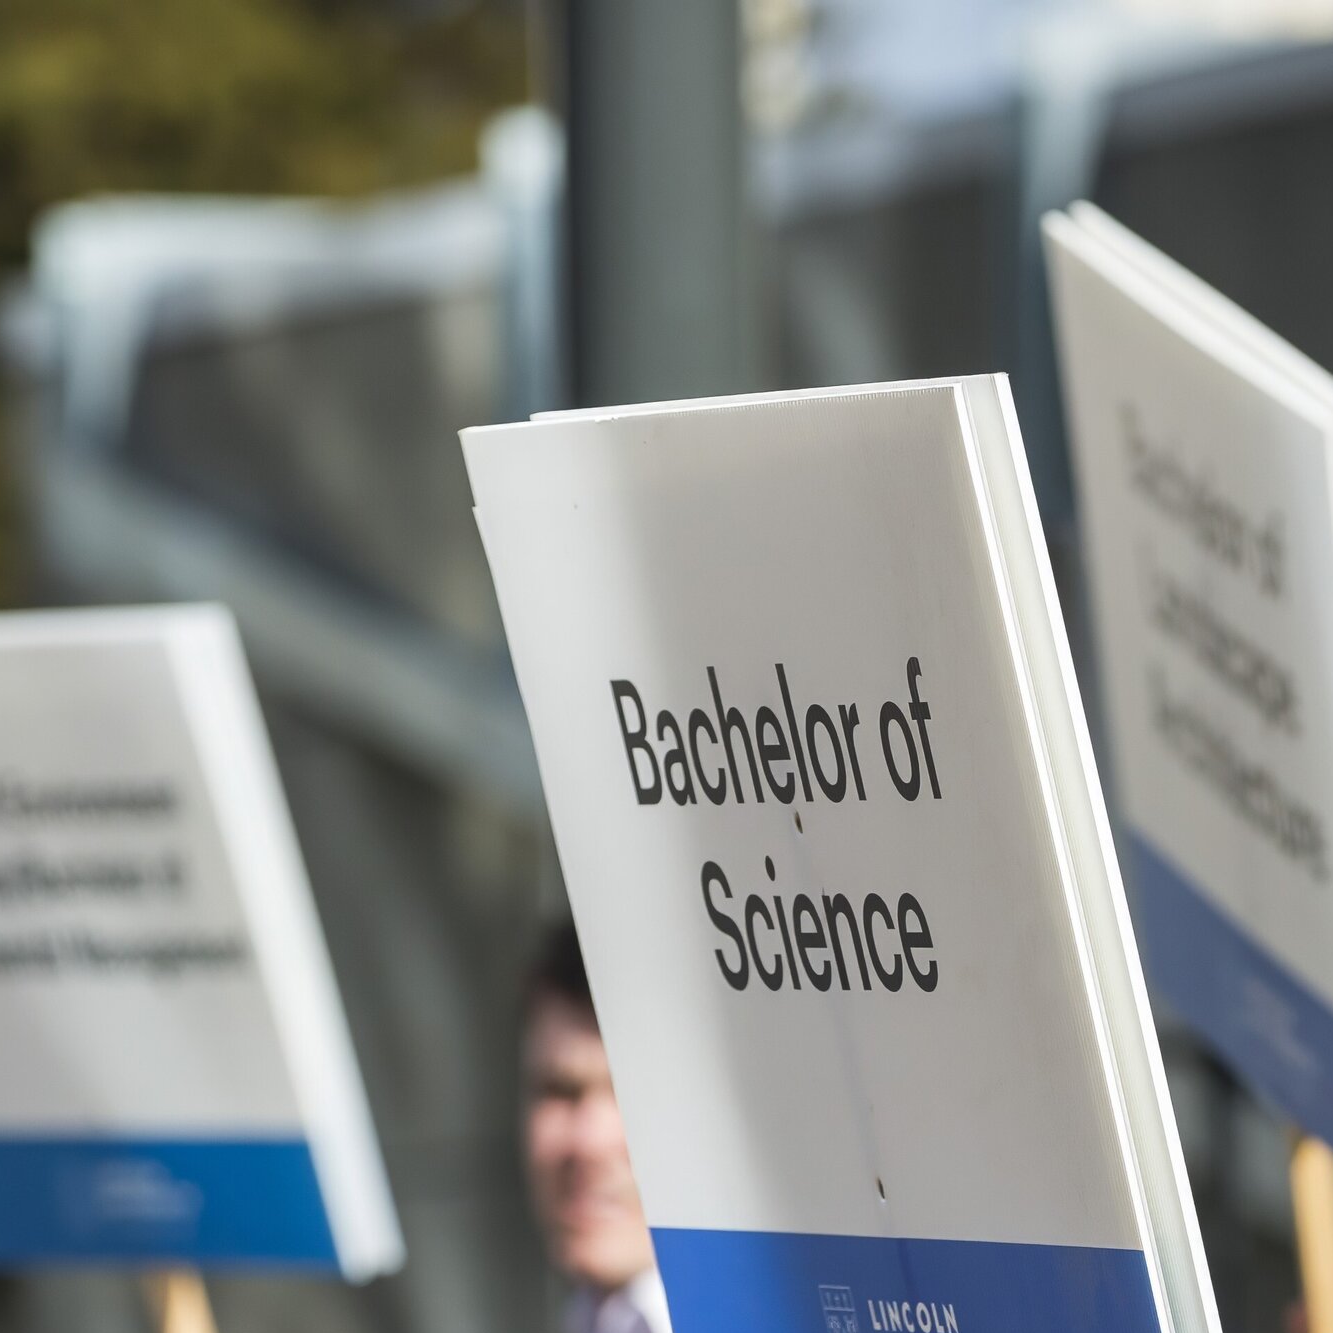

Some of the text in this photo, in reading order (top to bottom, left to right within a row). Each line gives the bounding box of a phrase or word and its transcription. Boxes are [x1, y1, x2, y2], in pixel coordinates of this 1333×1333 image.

[610, 656, 942, 806] Bachelor of
[701, 855, 938, 992] Science
